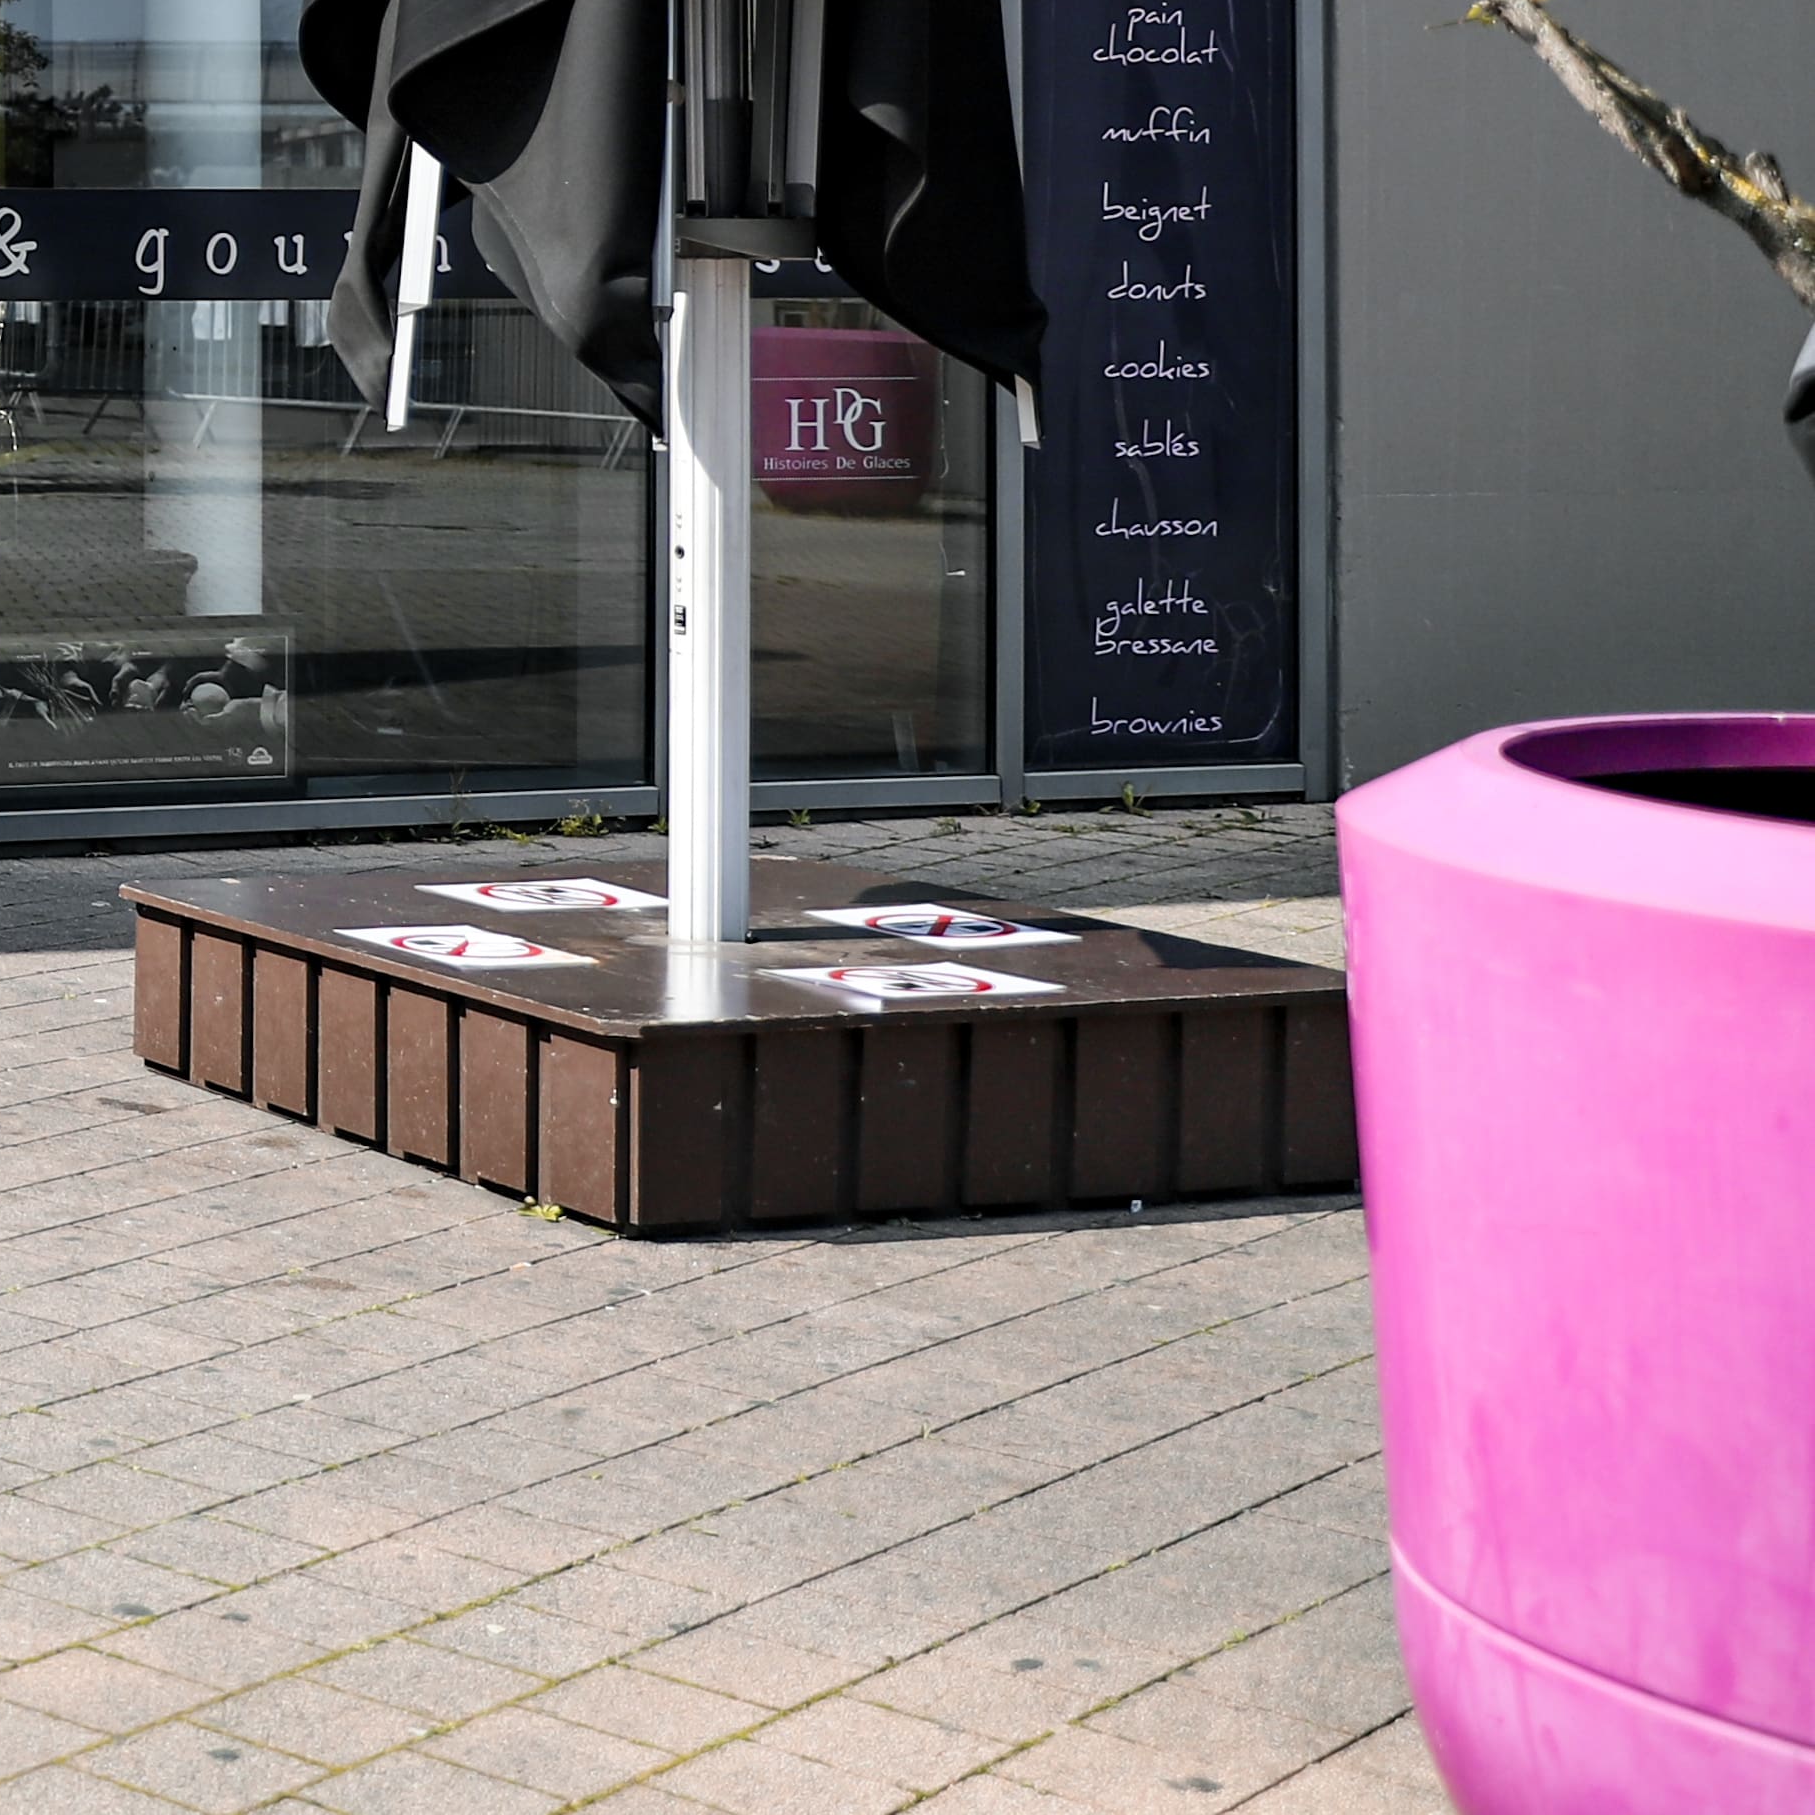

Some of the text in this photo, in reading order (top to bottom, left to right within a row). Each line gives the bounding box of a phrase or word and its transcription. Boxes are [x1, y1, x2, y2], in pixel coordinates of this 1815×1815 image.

[1127, 2, 1183, 41] pain
[1093, 23, 1219, 66] chocolat
[1102, 106, 1210, 144] muffin
[1103, 182, 1212, 241] beignet
[1107, 261, 1207, 300] donuts
[1103, 340, 1210, 379] cookies
[1114, 419, 1200, 458] sablés
[763, 455, 911, 471] Histoires De Glaces
[1095, 497, 1218, 539] chausson
[1097, 577, 1209, 635] galette
[1094, 618, 1219, 656] bressane
[1089, 696, 1223, 735] brownies
